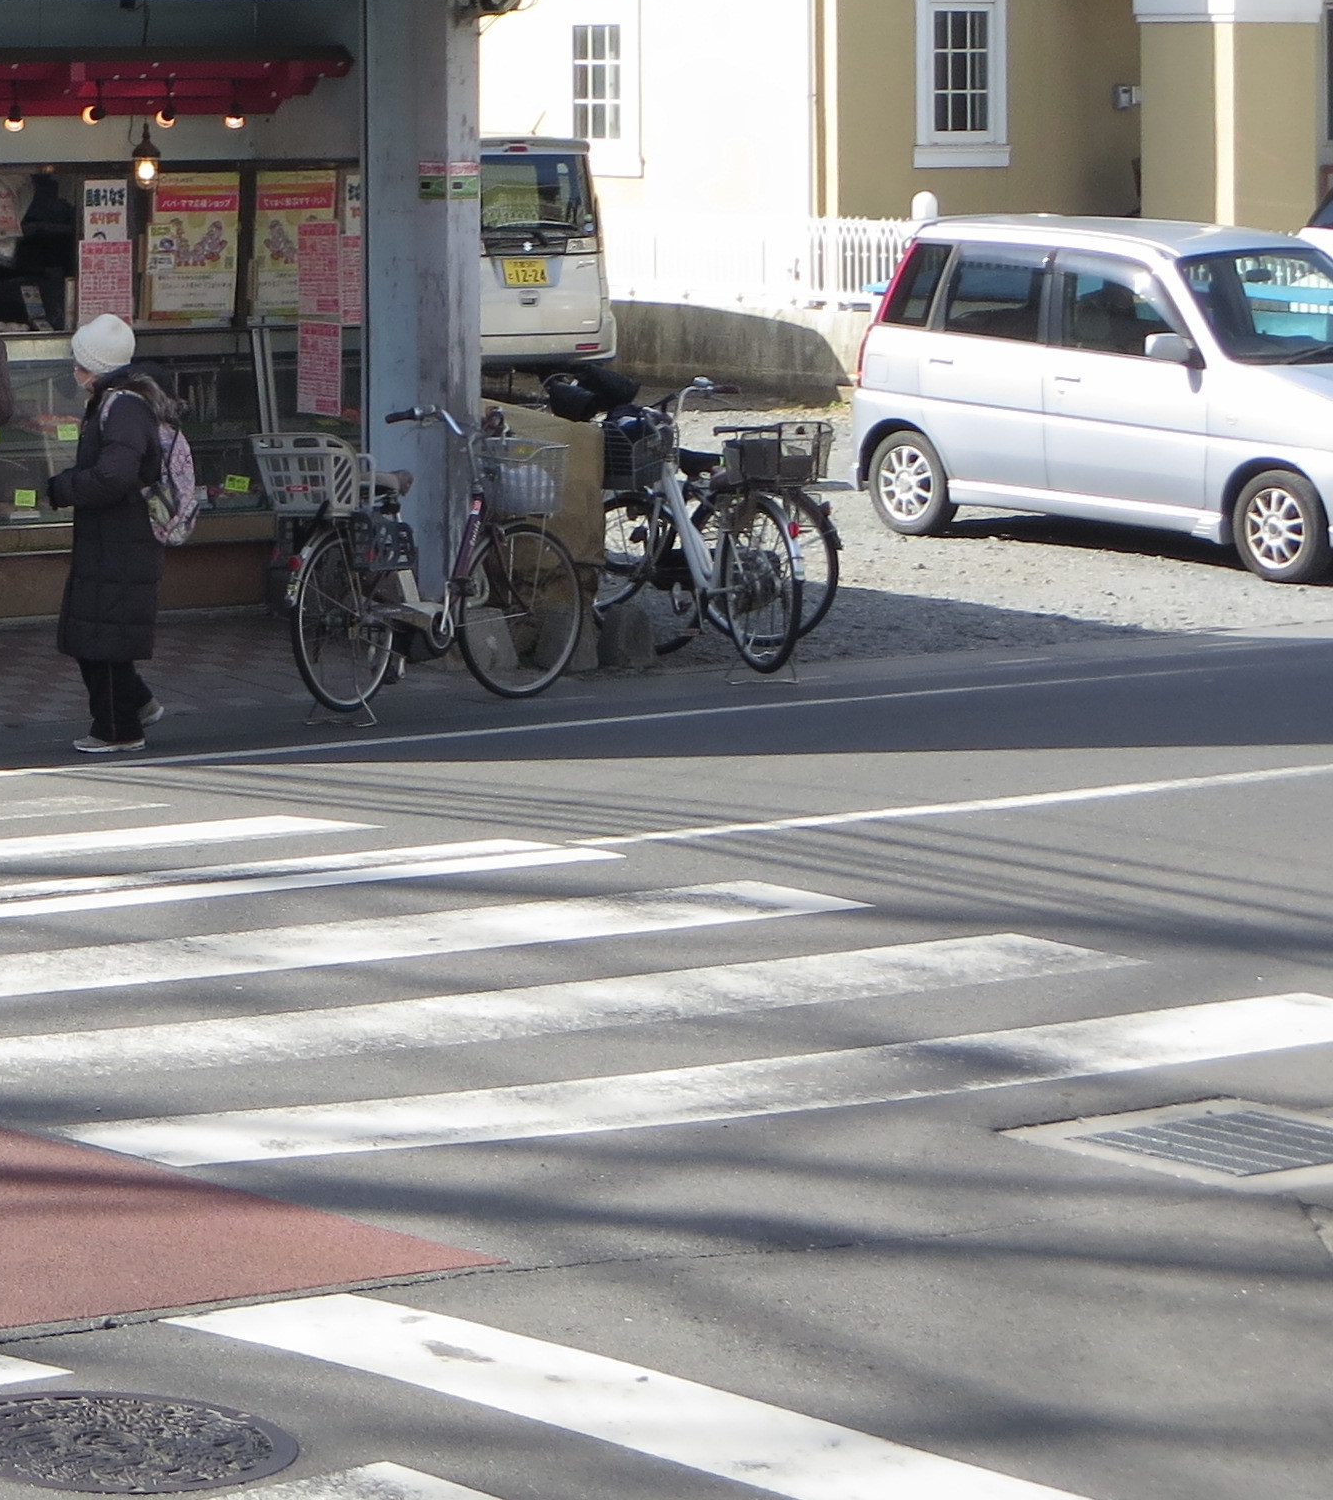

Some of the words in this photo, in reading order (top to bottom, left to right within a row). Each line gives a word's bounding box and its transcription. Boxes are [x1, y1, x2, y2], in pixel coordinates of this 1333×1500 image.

[85, 187, 126, 207] 国産うなぎ
[89, 211, 122, 225] あります
[515, 268, 547, 283] 12-24
